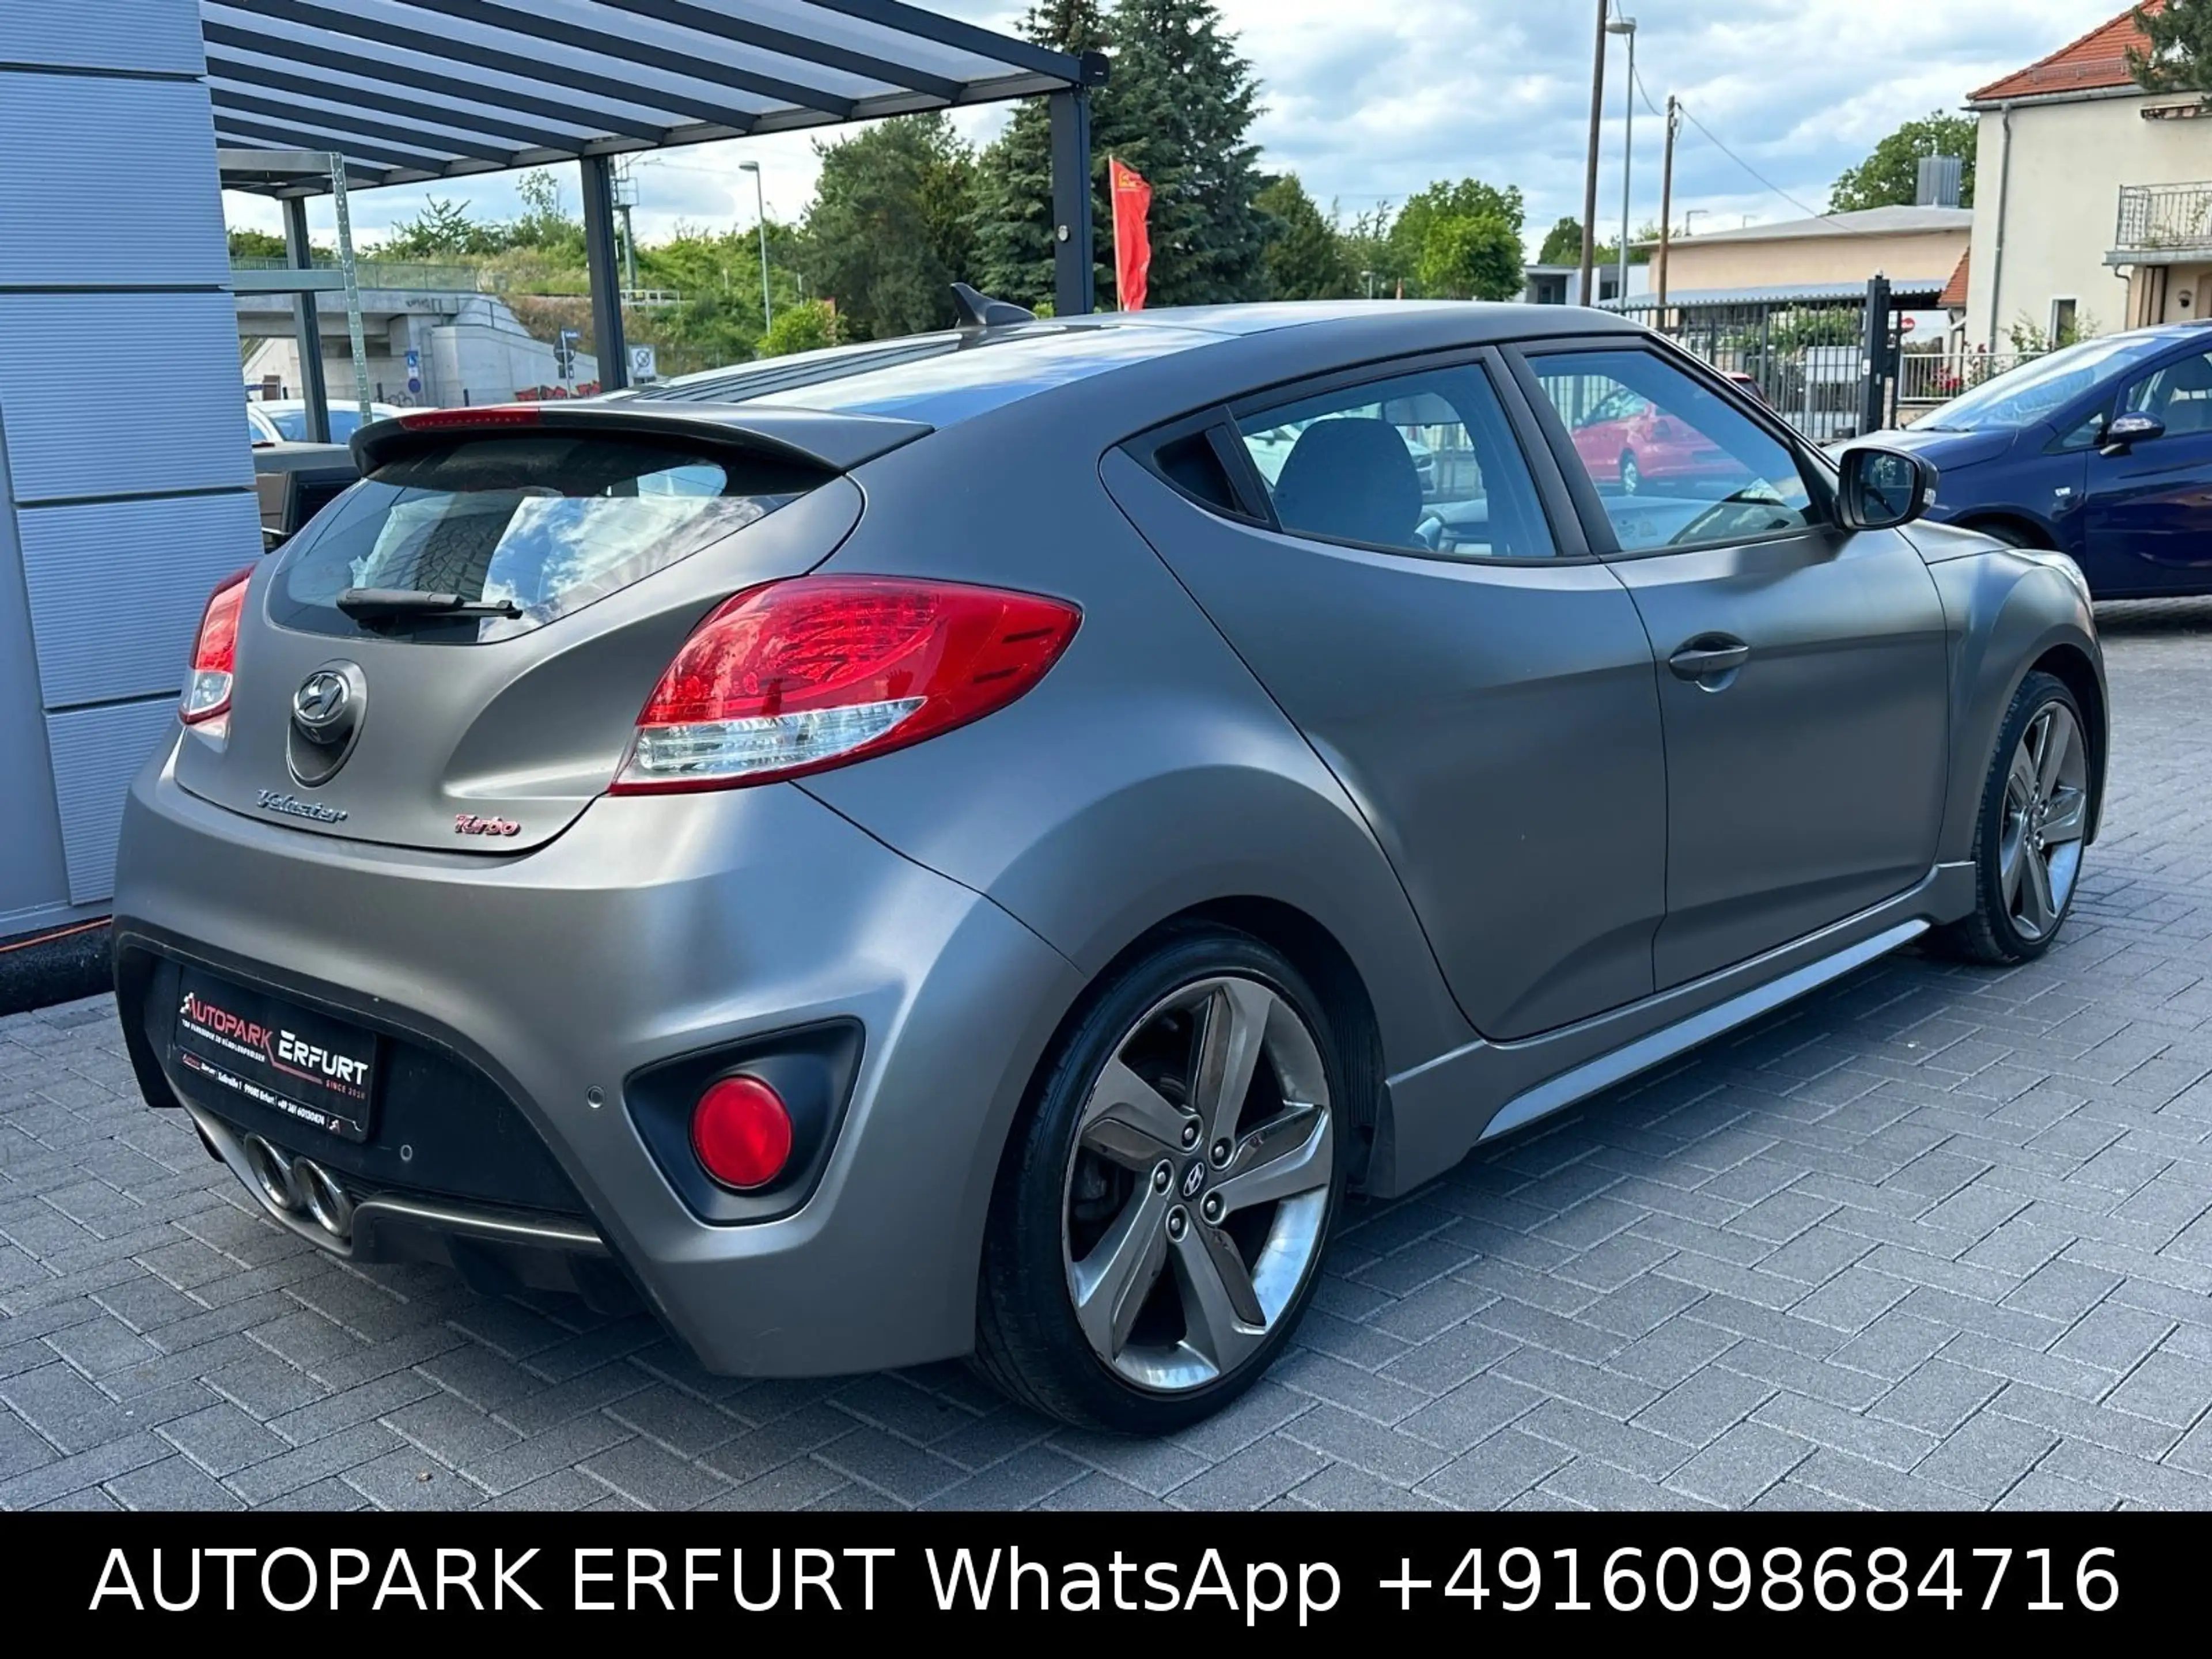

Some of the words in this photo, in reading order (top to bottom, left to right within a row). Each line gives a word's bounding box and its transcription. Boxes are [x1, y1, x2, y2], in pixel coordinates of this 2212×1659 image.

[455, 813, 521, 836] Turbo
[180, 992, 273, 1049] AUTOPARK
[278, 1029, 369, 1085] ERFURT
[325, 1080, 346, 1093] SINCE
